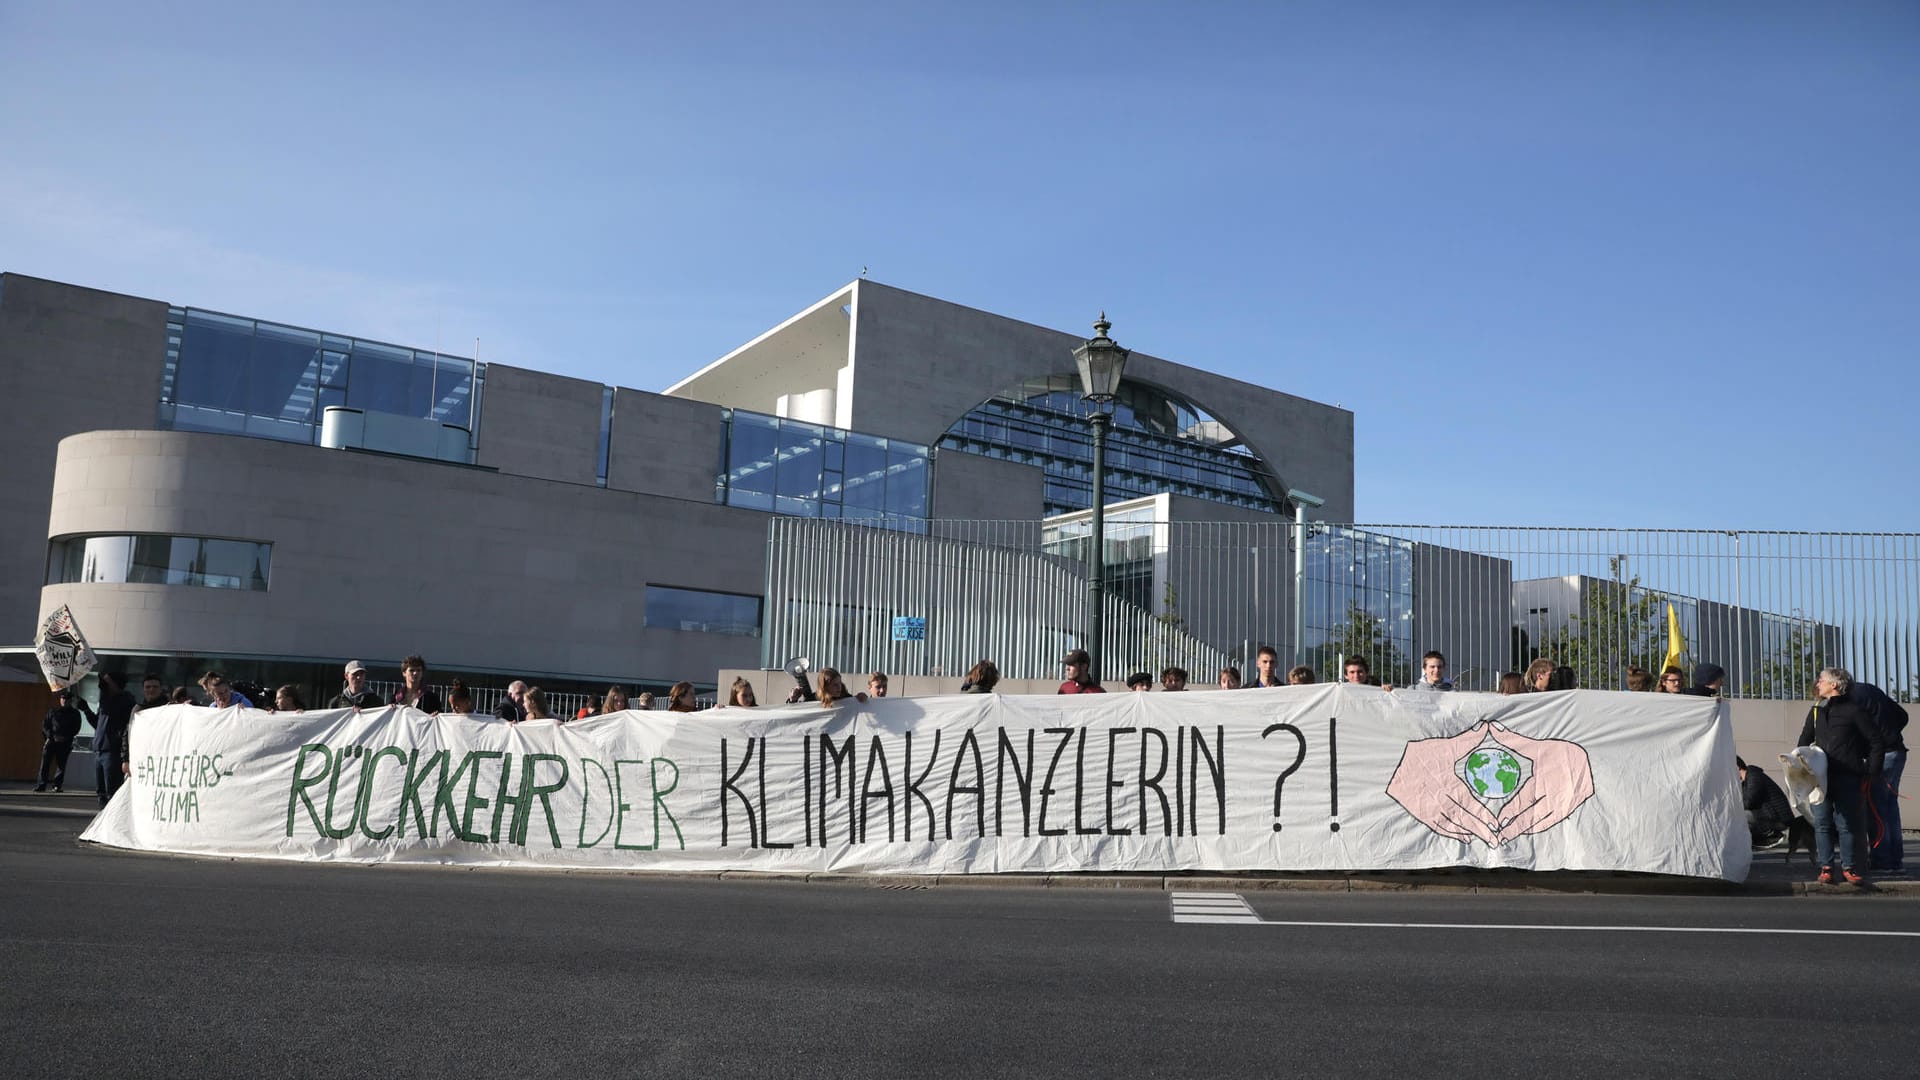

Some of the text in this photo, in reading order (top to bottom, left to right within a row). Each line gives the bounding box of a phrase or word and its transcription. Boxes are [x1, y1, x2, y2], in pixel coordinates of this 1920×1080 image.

[894, 627, 925, 640] WE RISE
[52, 651, 73, 661] WILL
[286, 743, 569, 849] RÜCKKEHR
[577, 756, 686, 851] DER
[720, 724, 1226, 849] KLIMAKANZLERIN
[152, 789, 200, 823] KLIMA
